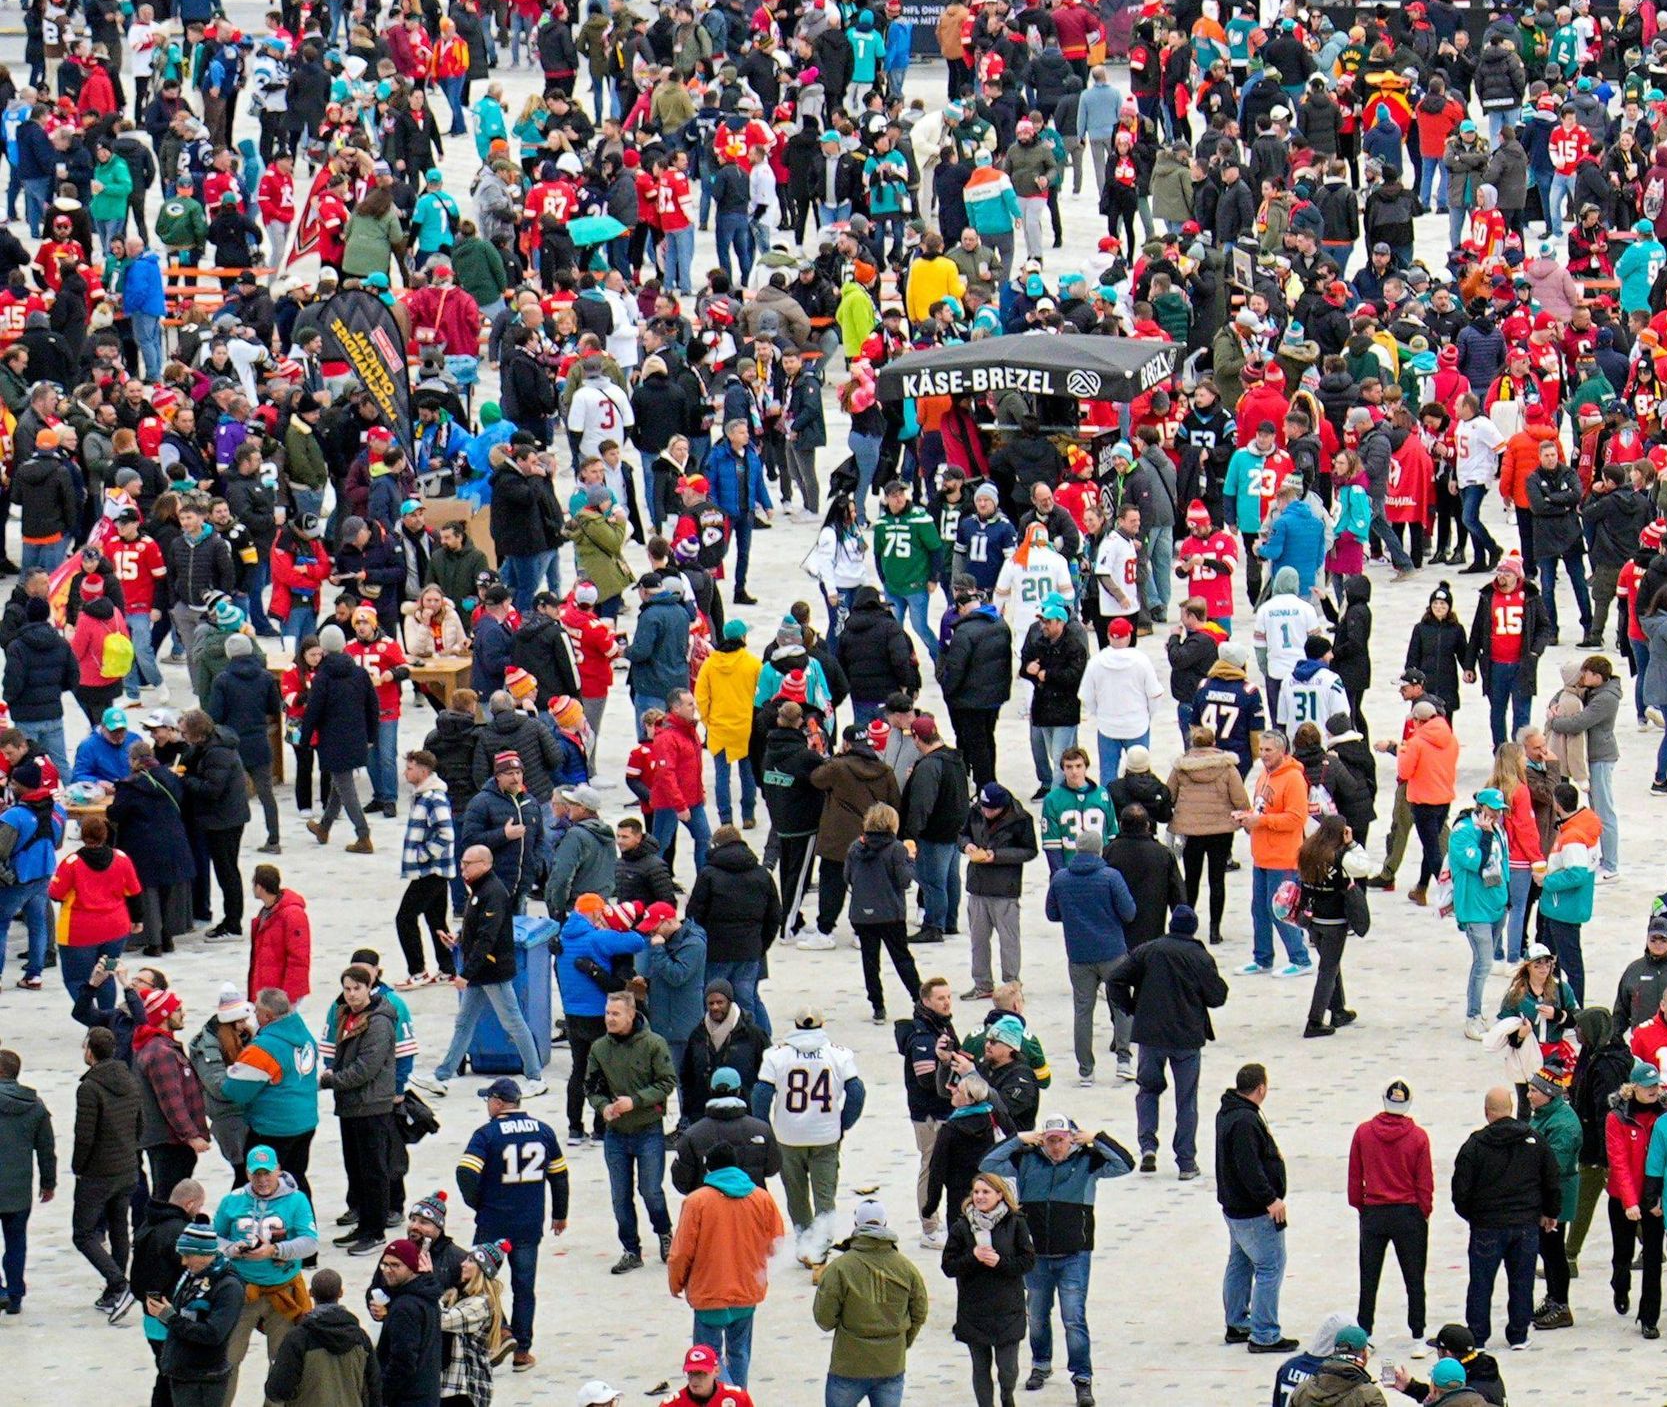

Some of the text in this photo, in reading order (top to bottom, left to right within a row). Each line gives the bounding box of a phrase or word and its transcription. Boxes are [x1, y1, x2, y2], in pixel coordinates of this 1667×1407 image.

[858, 40, 865, 58] 1
[1559, 141, 1576, 163] 15
[543, 196, 568, 219] 87
[903, 367, 1055, 398] KÄSE-BREZEL
[600, 401, 614, 430] 3
[1248, 468, 1276, 494] 23
[884, 533, 911, 557] 75
[969, 538, 987, 563] 11
[116, 551, 138, 580] 15
[1021, 576, 1054, 602] 20
[1495, 607, 1522, 635] 15
[1281, 623, 1291, 649] 1
[1294, 691, 1317, 722] 31
[1202, 703, 1240, 739] 47
[785, 1068, 832, 1114] 84
[499, 1118, 540, 1134] BRADY
[501, 1141, 546, 1184] 12
